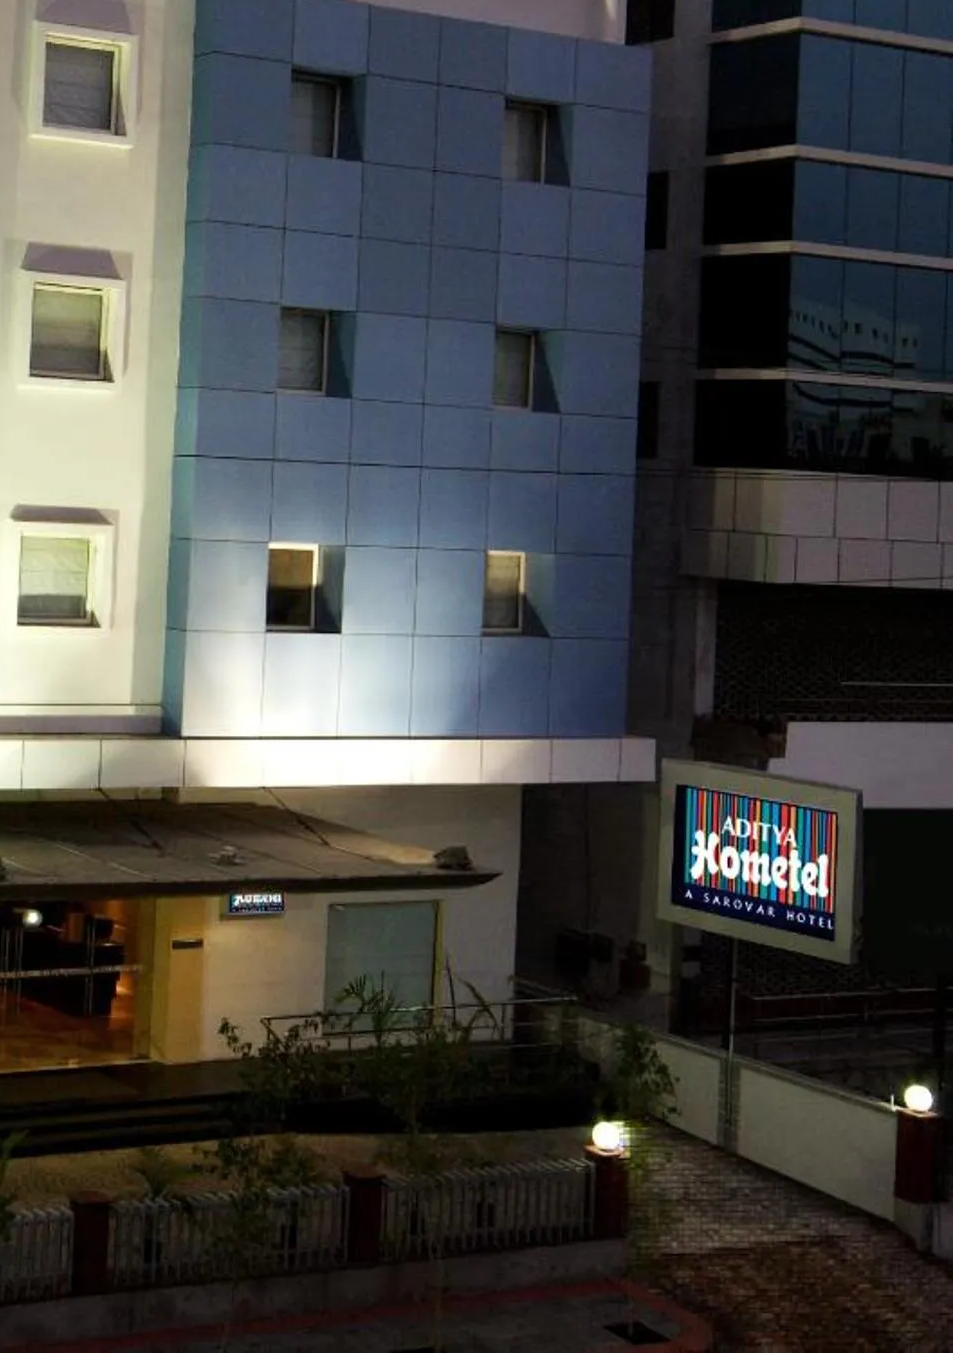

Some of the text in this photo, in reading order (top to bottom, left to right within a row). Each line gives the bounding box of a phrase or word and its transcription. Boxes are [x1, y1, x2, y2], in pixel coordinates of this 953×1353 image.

[721, 815, 797, 847] ADITYA
[691, 829, 828, 897] Hometel
[685, 889, 834, 930] A SAROVAR HOTEL
